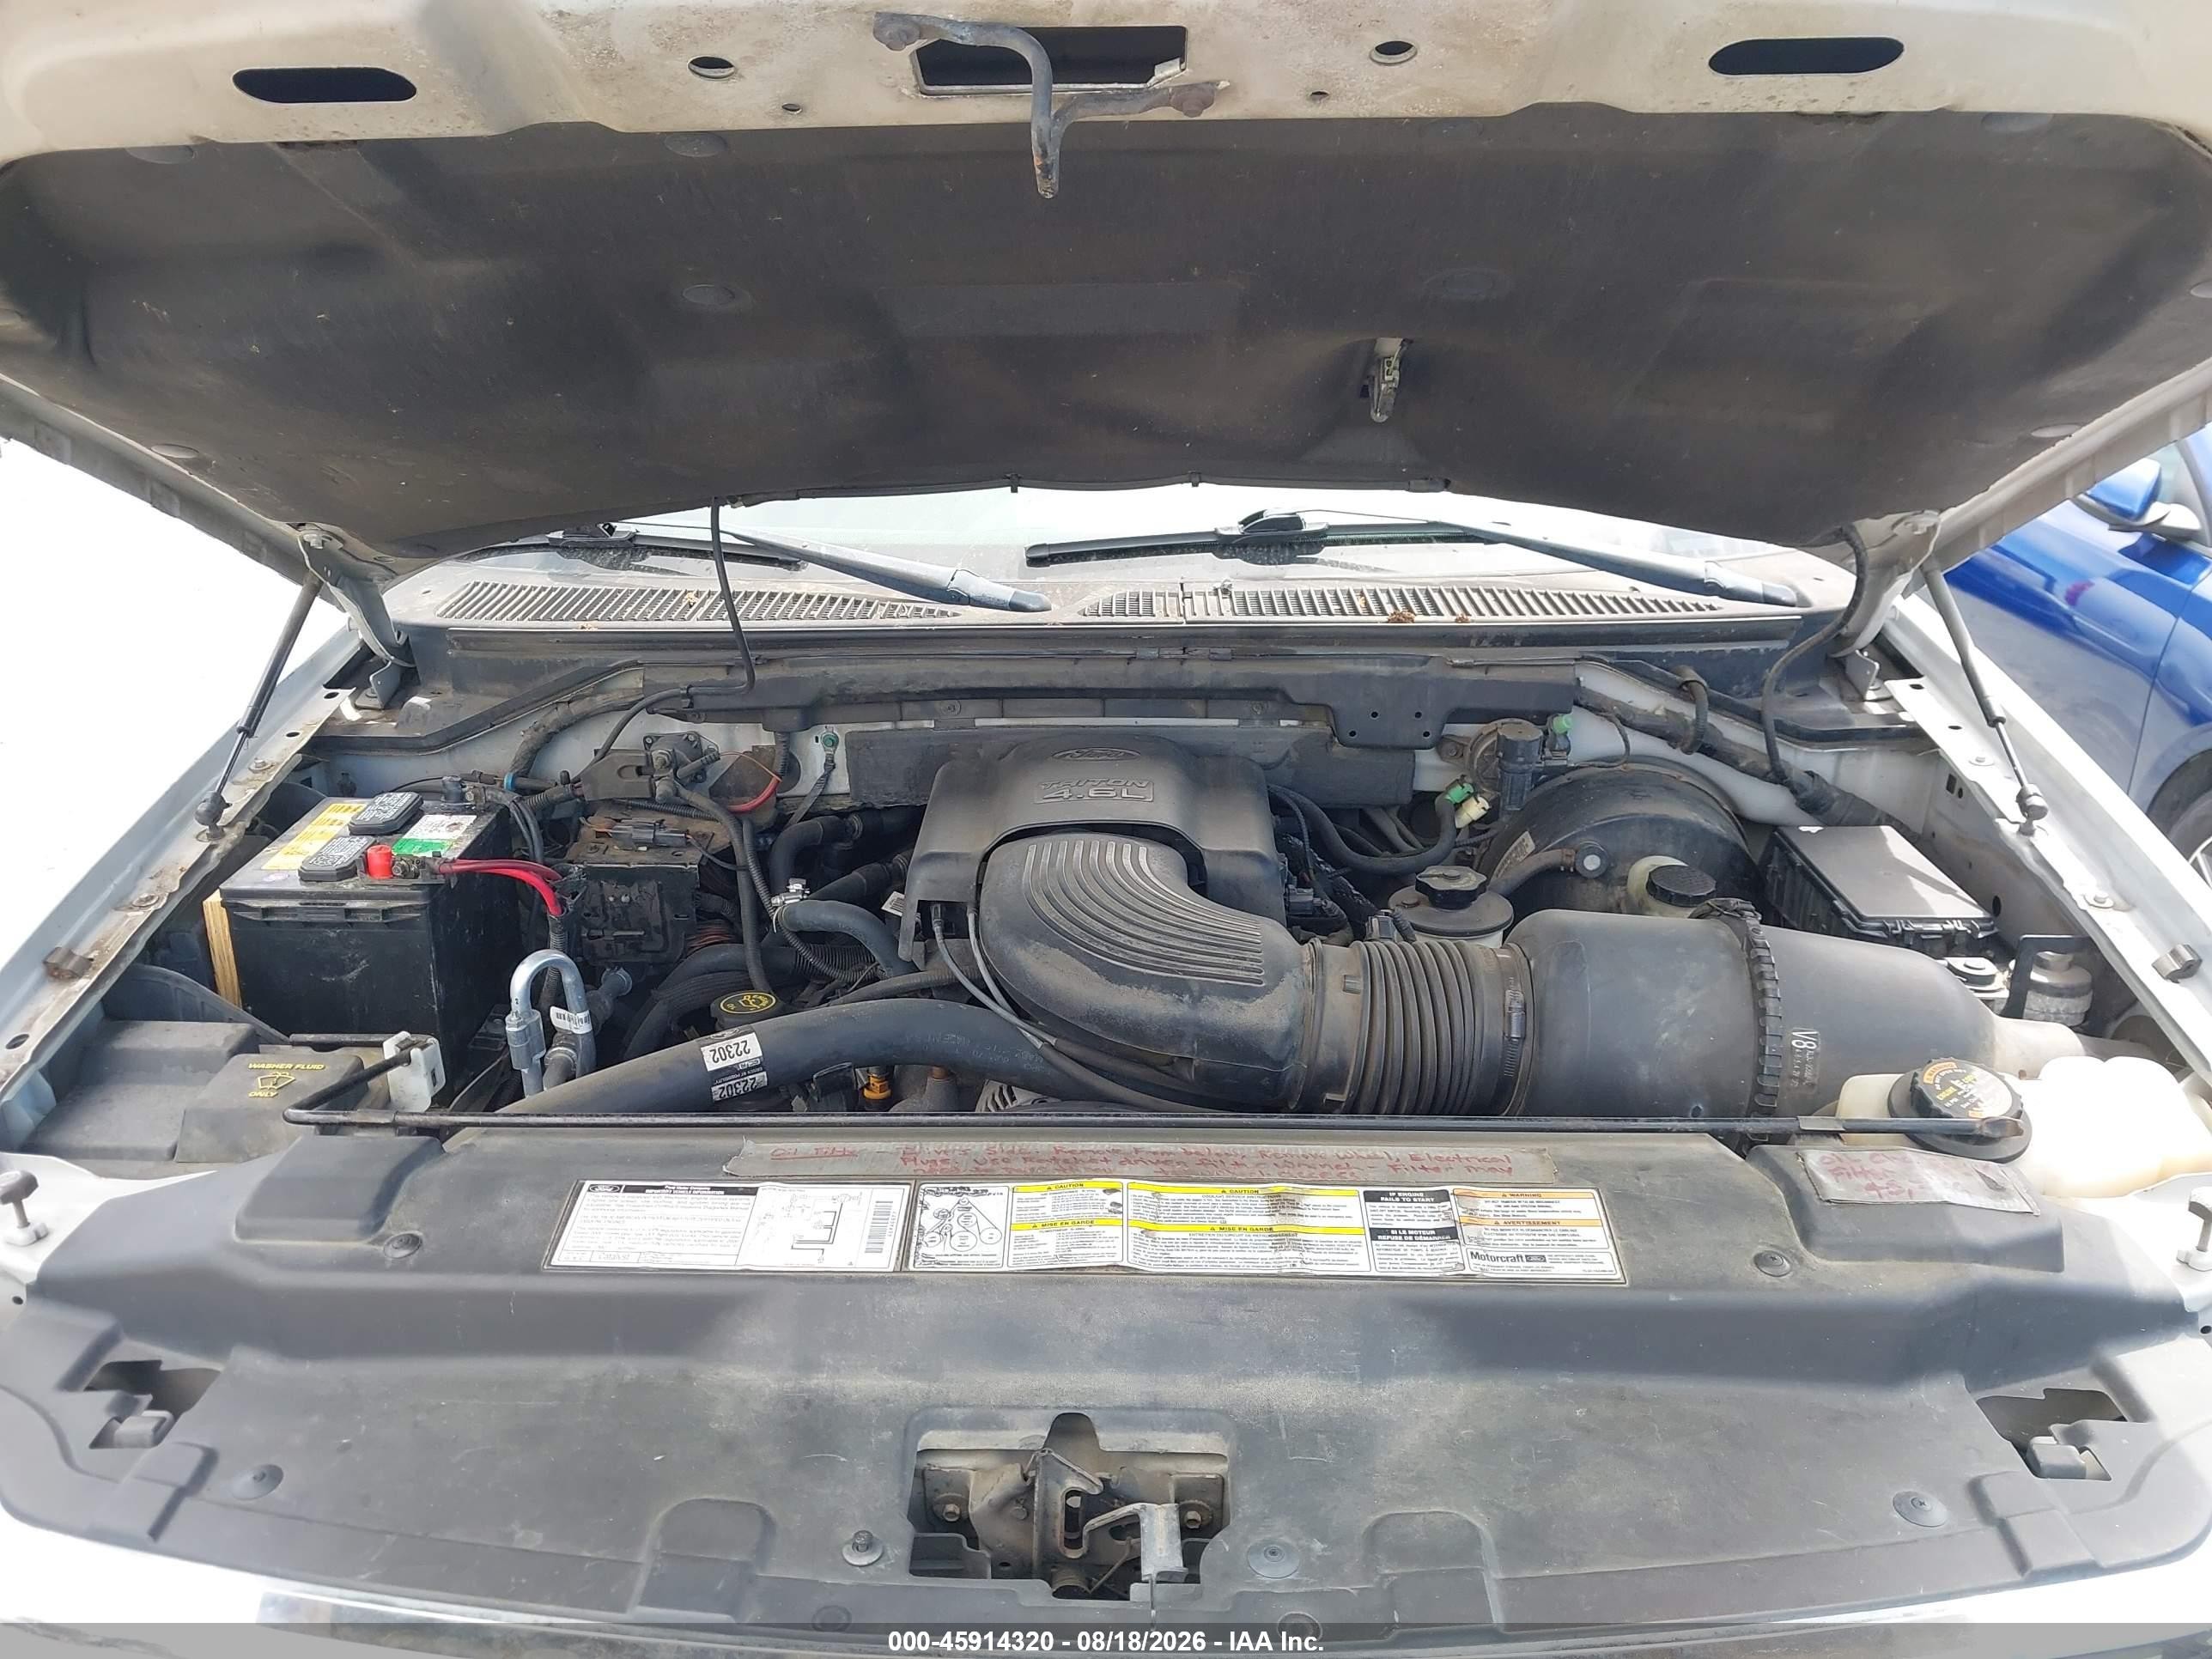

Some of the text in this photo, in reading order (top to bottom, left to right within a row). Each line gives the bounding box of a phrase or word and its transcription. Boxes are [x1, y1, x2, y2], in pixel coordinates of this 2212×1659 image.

[1042, 787, 1147, 800] 4.6L
[1791, 1031, 1819, 1049] V8
[708, 1039, 751, 1063] 22302
[719, 1076, 757, 1099] 22302
[1407, 1152, 1511, 1164] Electrical
[1464, 1164, 1513, 1176] may
[1469, 1250, 1525, 1263] Motorcraft
